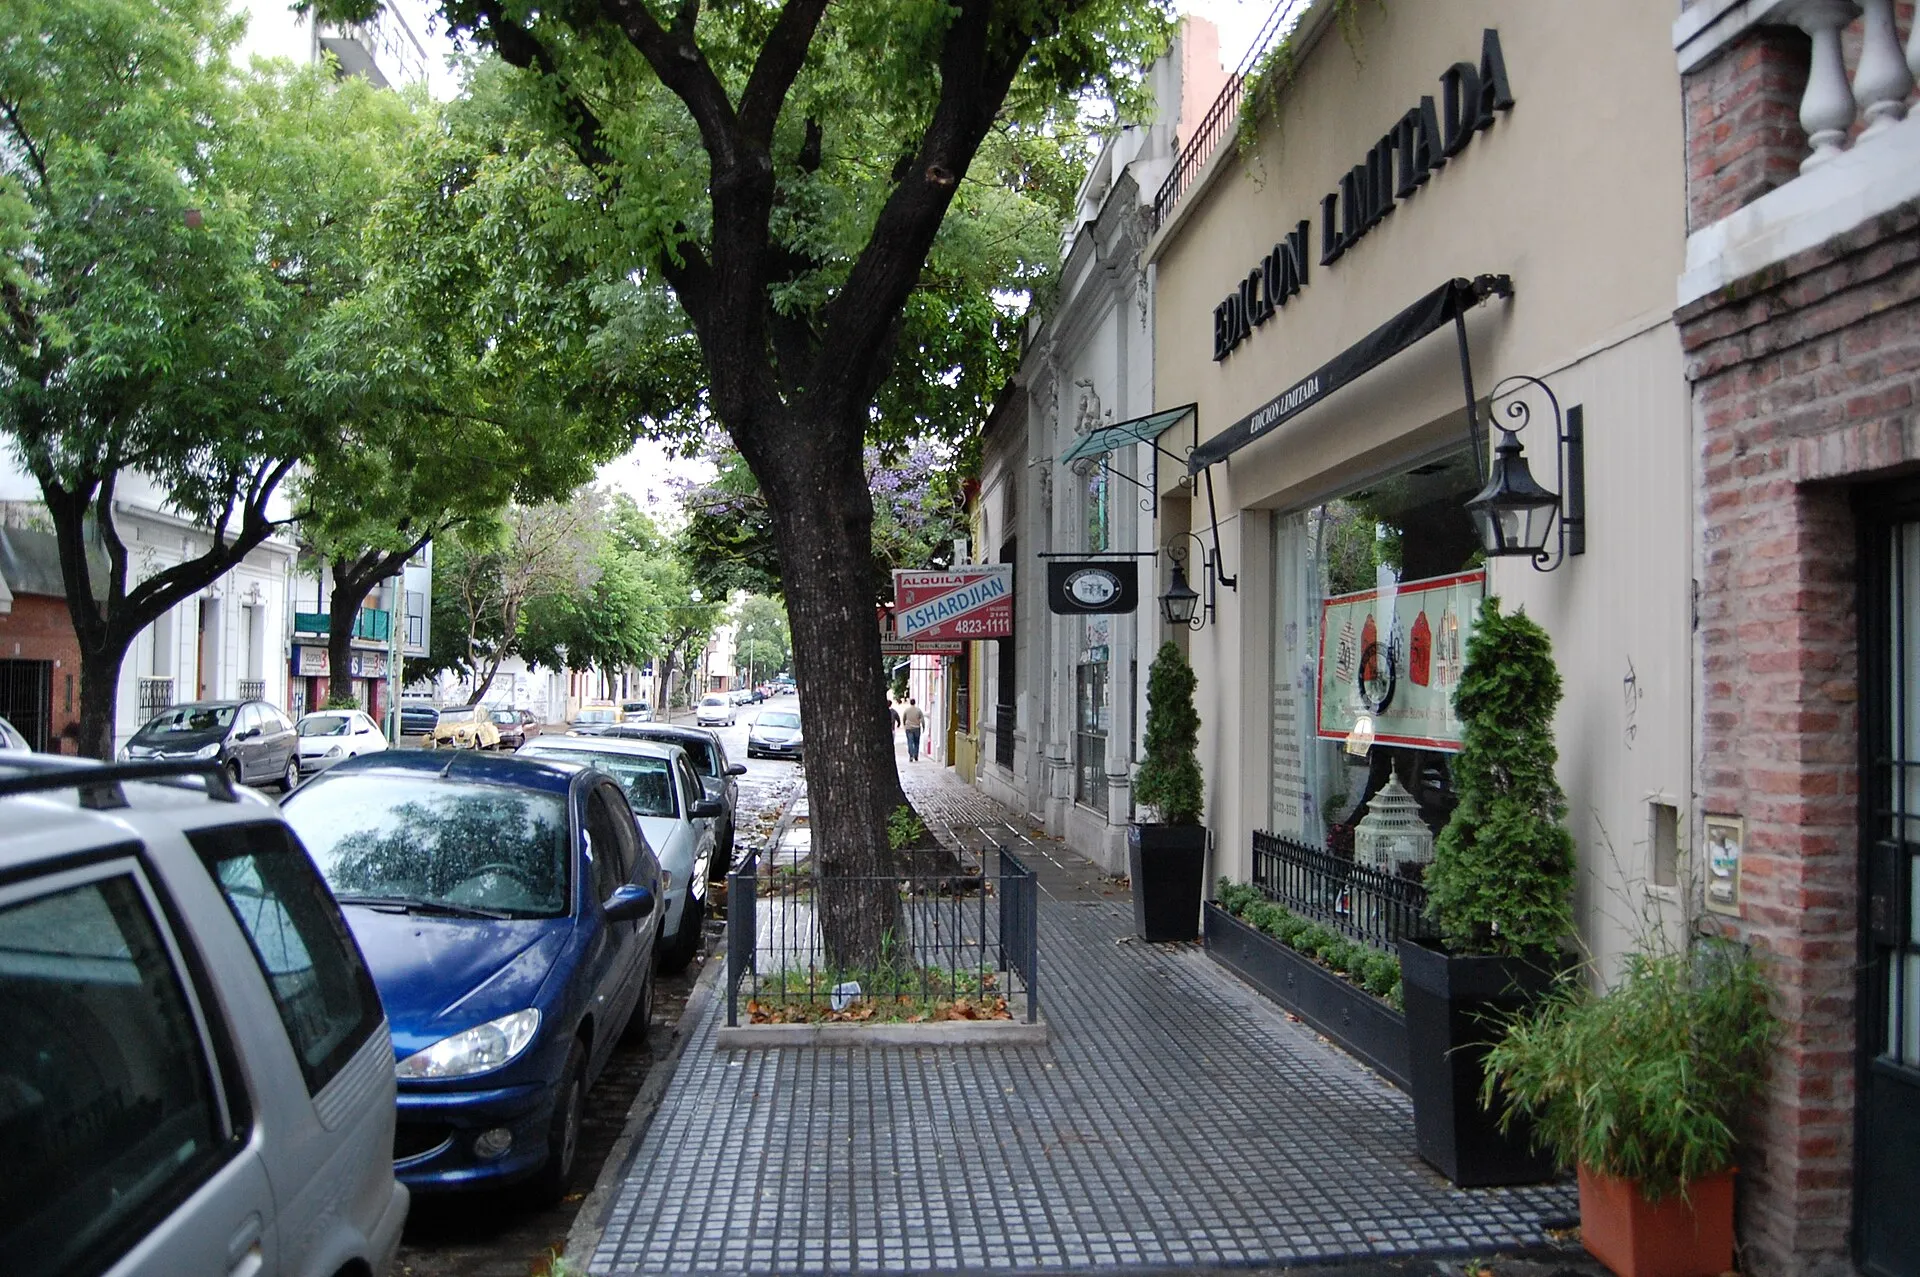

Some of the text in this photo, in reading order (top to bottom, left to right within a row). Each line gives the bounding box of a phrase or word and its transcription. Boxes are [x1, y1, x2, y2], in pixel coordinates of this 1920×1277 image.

[1212, 28, 1515, 361] EDICION LIMITADA
[1250, 376, 1319, 434] EDICION LIMITADA
[902, 576, 962, 585] ALQUILA
[906, 577, 1004, 632] ASHARDJIAN
[955, 619, 1009, 633] 4823-1111
